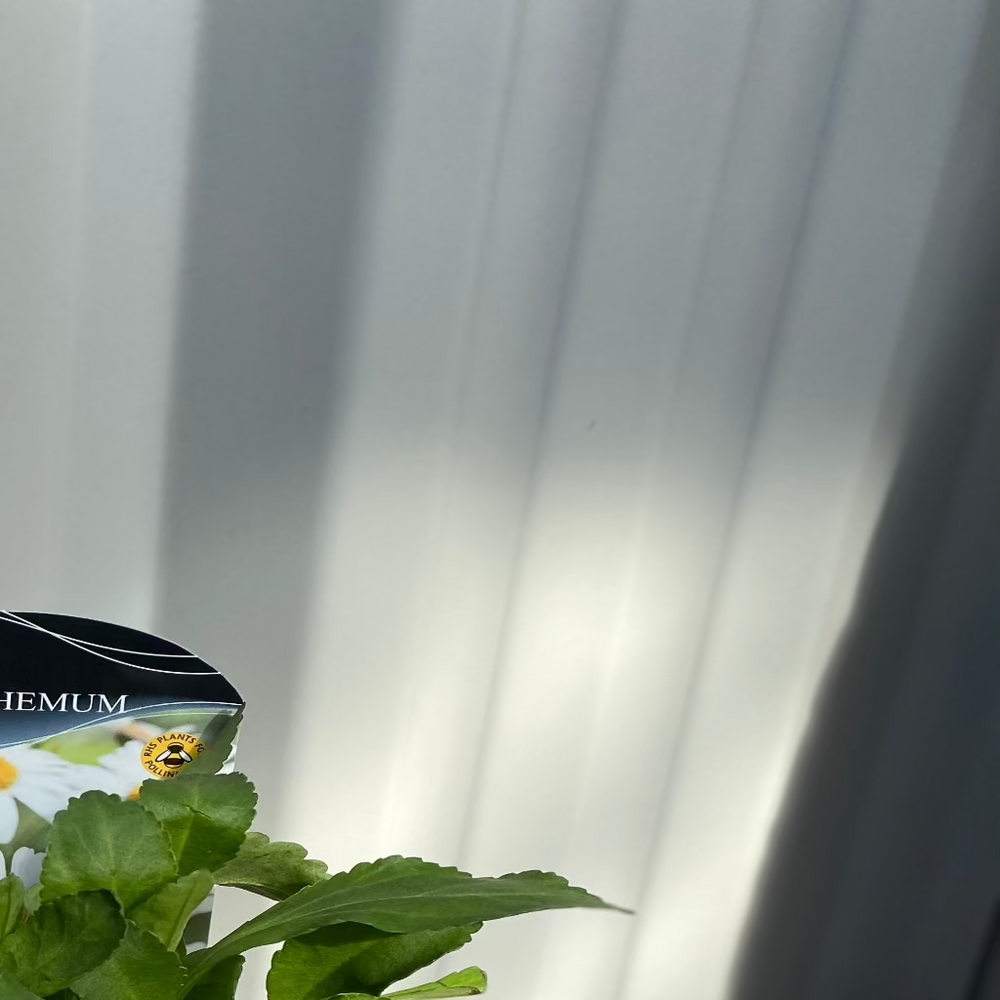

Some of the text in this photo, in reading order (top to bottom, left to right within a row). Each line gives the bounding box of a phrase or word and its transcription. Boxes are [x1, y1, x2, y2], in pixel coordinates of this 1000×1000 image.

[144, 733, 205, 757] RHS PLANTS FO
